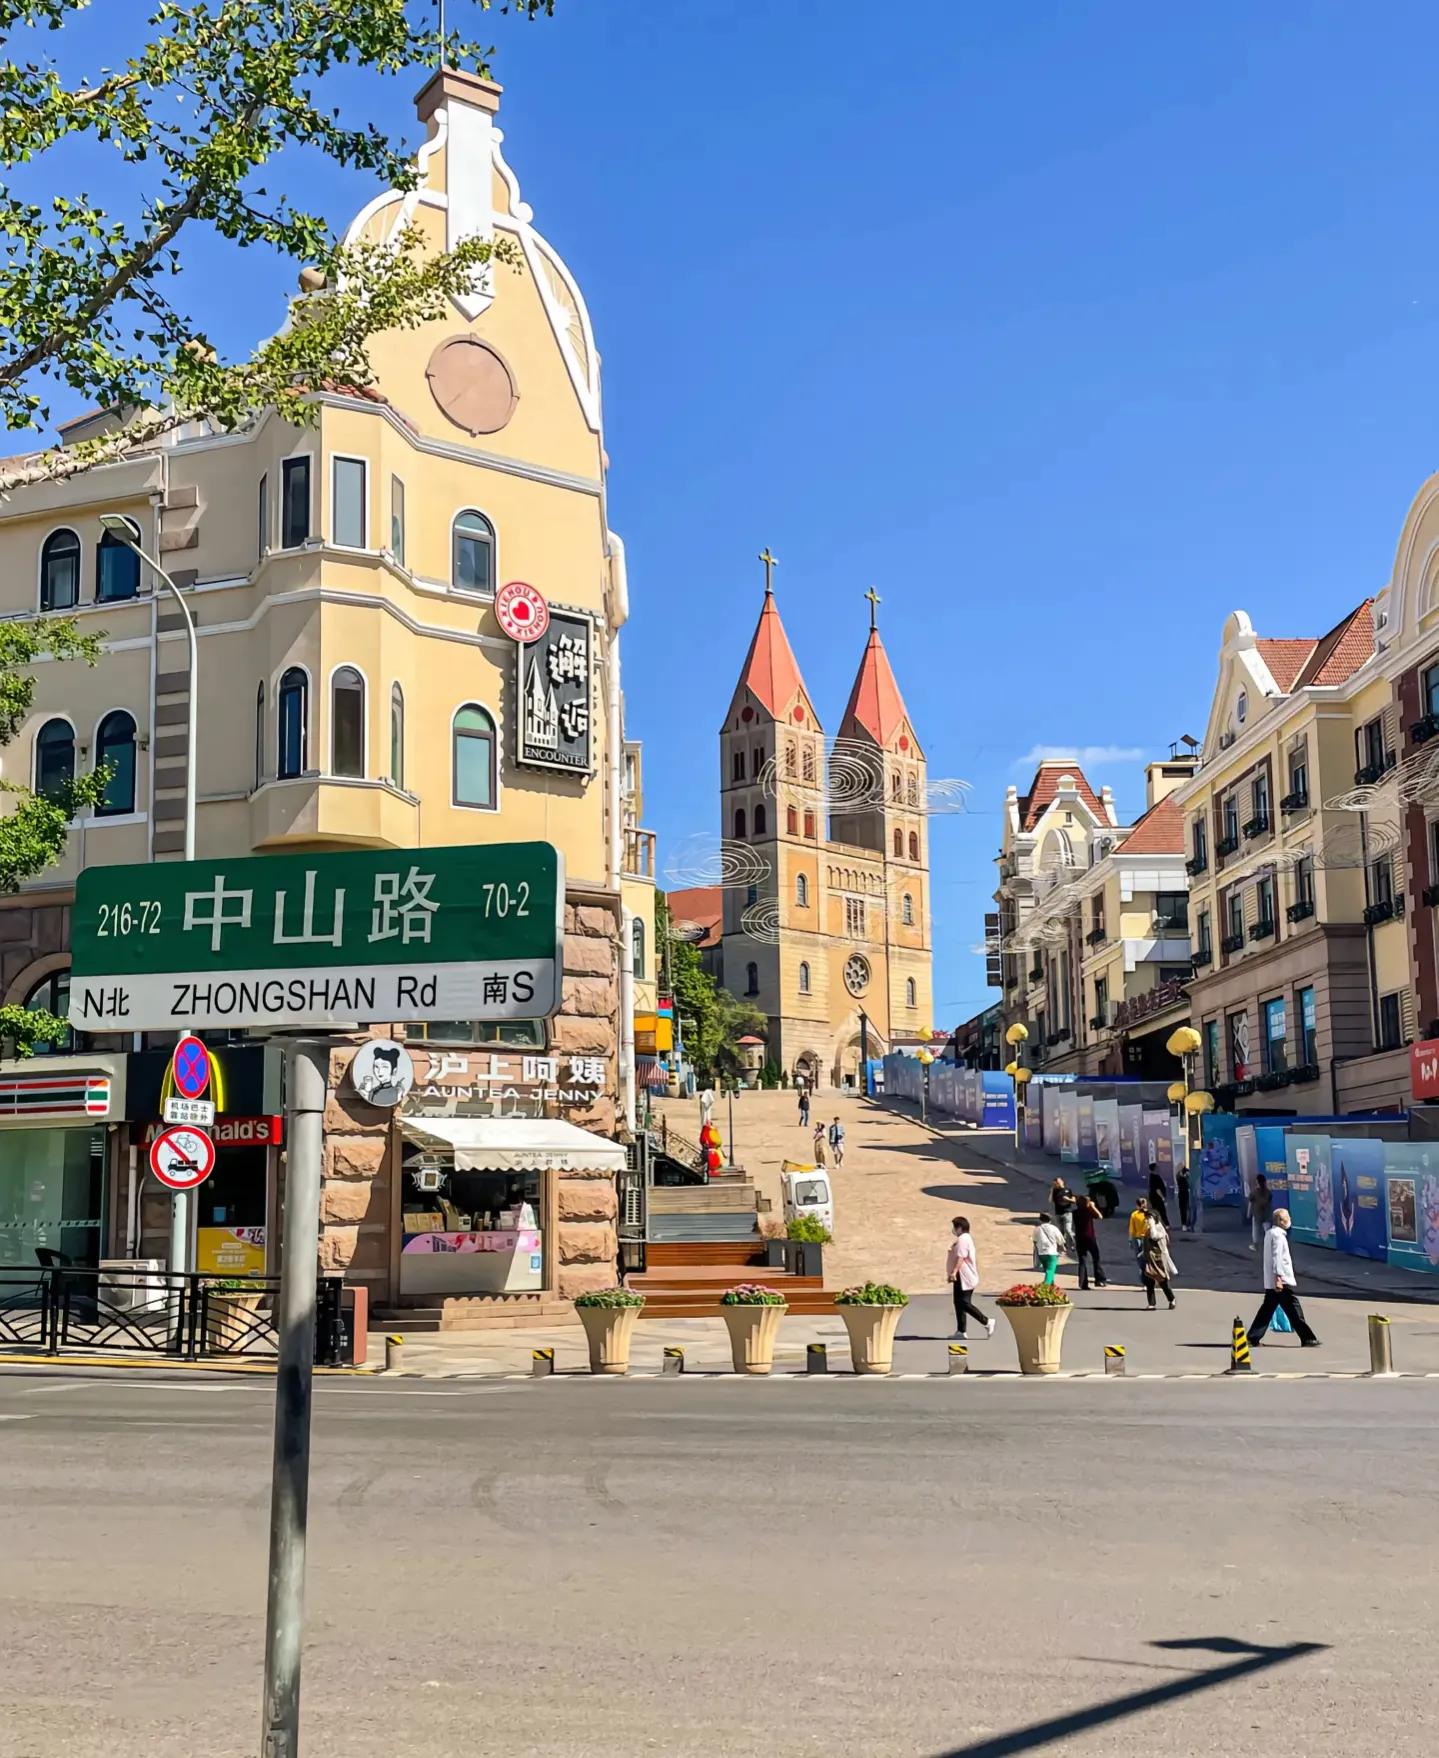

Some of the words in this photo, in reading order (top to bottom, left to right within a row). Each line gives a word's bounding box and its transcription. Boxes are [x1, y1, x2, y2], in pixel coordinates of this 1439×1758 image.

[525, 746, 589, 767] ENCOUNTER
[183, 866, 440, 951] 中山路
[483, 881, 530, 918] 70-2
[97, 901, 161, 937] 216-72
[171, 976, 375, 1016] ZHONGSHAN
[397, 974, 437, 1008] Rd
[423, 1052, 606, 1084] 沪上阿姨
[423, 1085, 520, 1099] AUNTEA
[530, 1088, 605, 1101] JENNY
